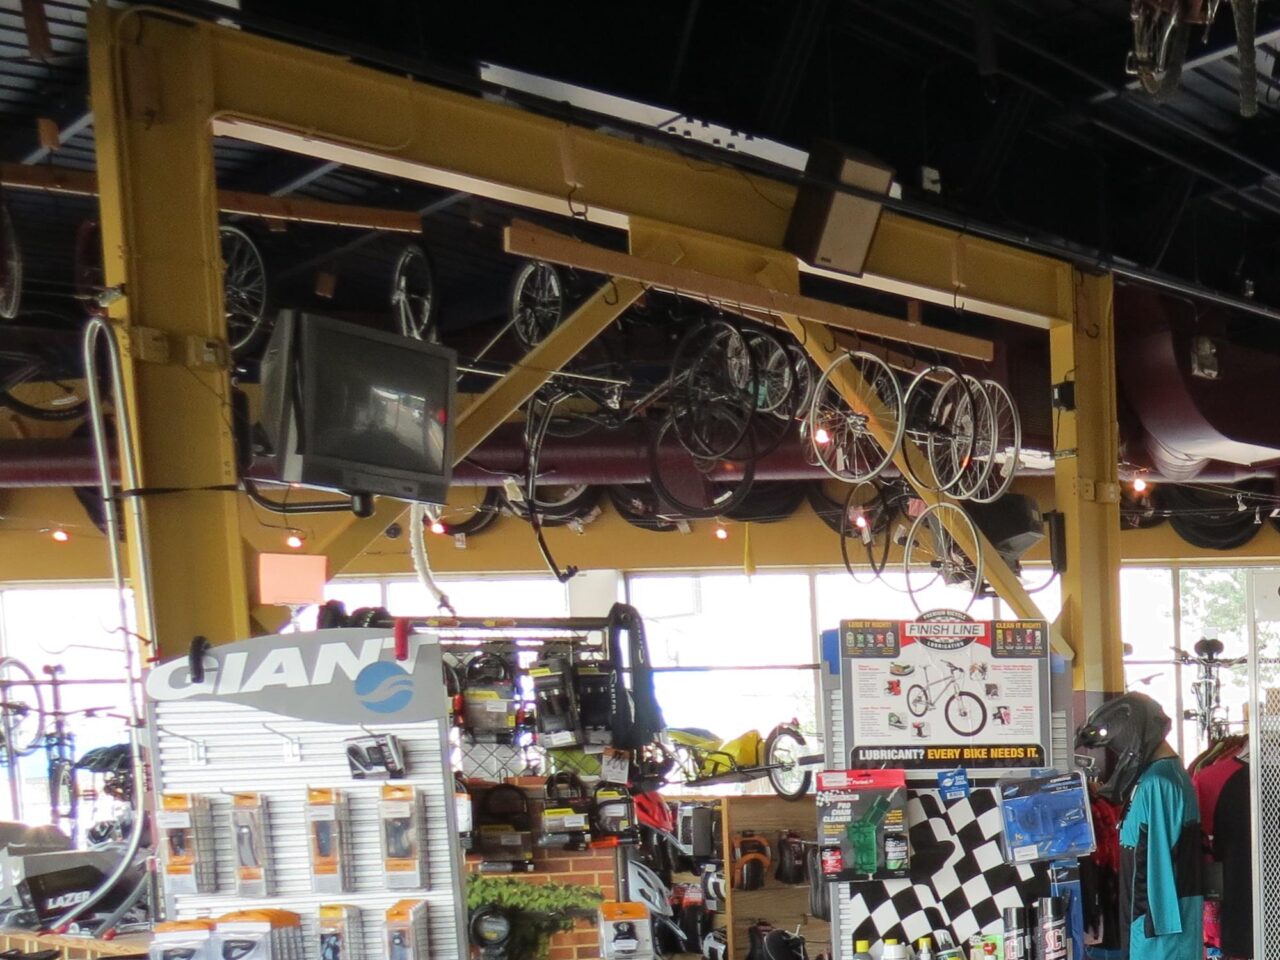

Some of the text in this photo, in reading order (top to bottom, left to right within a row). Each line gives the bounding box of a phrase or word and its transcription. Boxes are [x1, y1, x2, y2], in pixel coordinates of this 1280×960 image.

[909, 624, 981, 636] FINISH LINE
[927, 640, 965, 650] LUBRICATION
[145, 638, 439, 701] GIANT
[859, 748, 1039, 760] LUBRICANT? EVERY BIKE NEEDS IT.
[47, 891, 92, 909] LAZER
